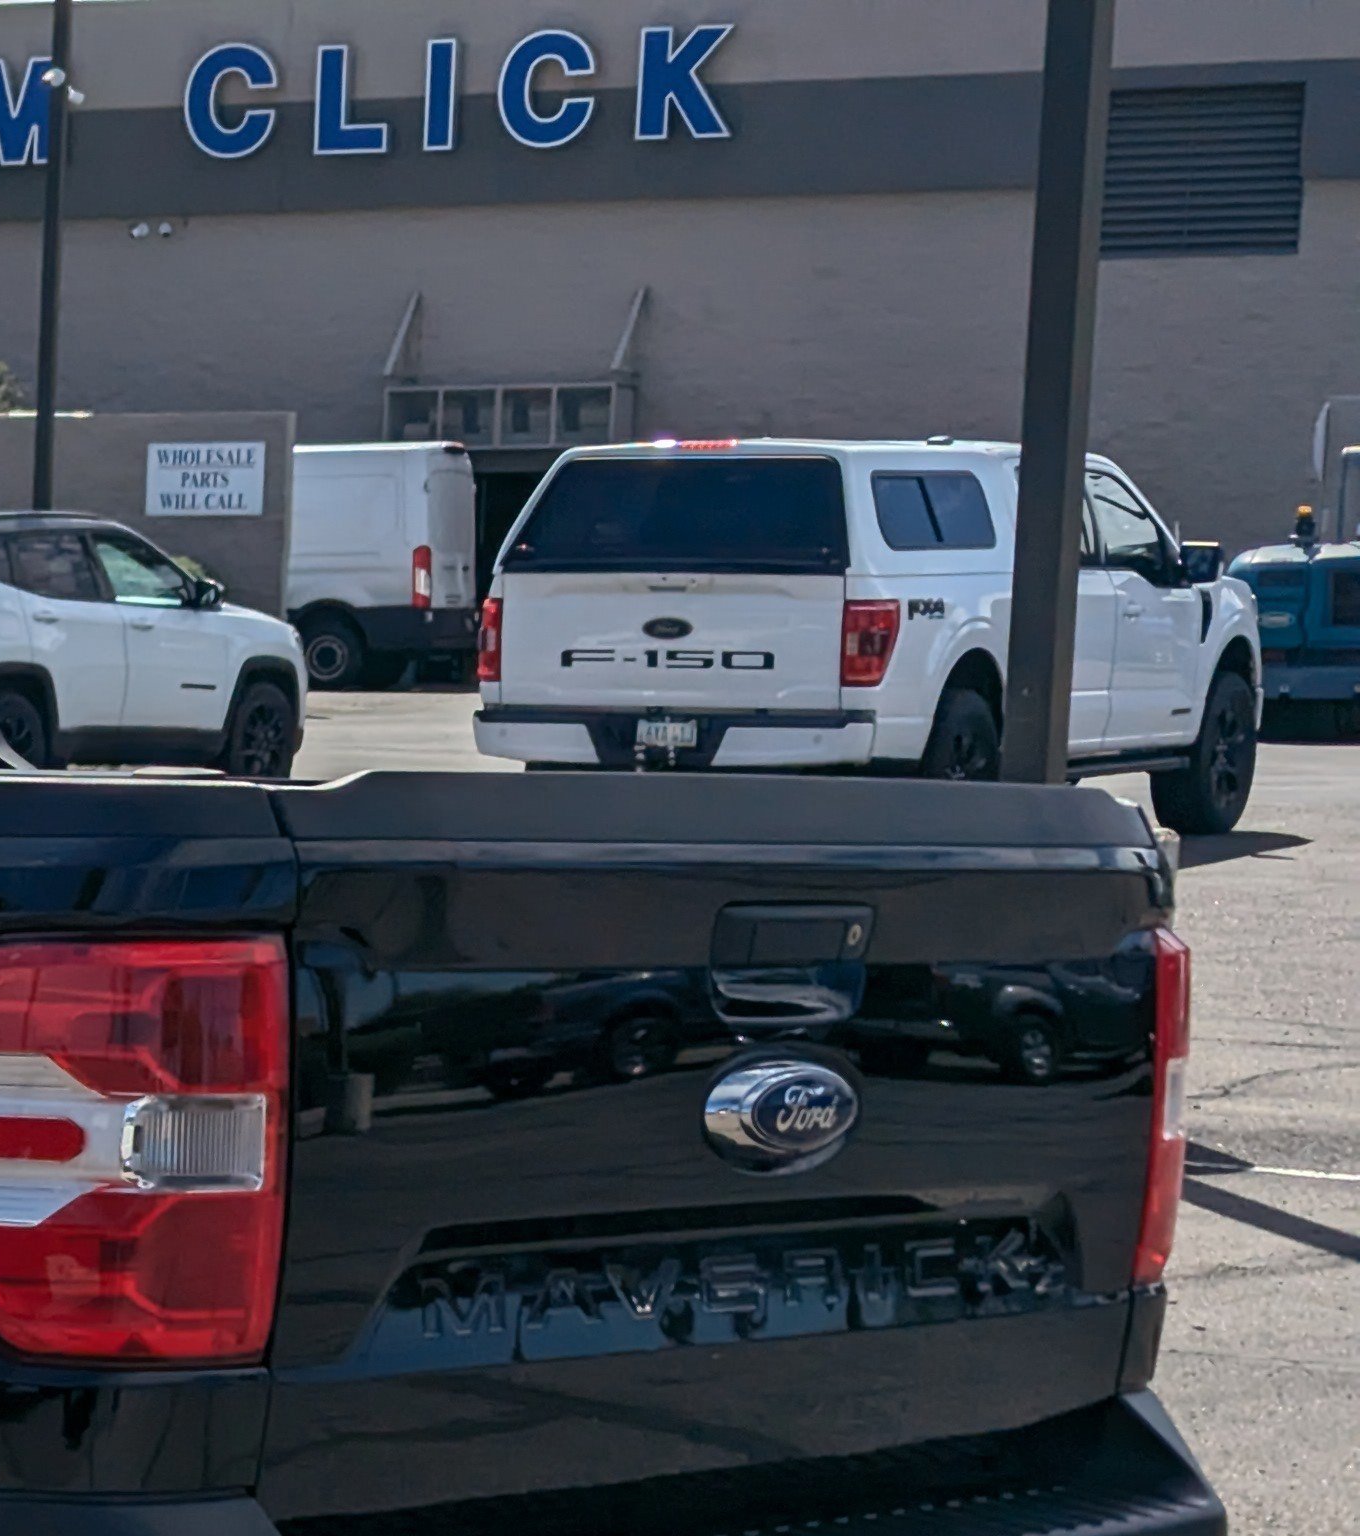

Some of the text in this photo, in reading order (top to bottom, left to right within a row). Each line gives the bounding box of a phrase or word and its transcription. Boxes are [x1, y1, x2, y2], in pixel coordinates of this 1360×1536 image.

[183, 23, 735, 159] CLICK
[157, 448, 256, 467] WHOLESALE
[181, 471, 230, 488] PARTS
[160, 493, 248, 510] WILL CALL
[561, 649, 775, 670] F-150
[775, 1084, 843, 1135] Ford
[420, 1226, 1066, 1340] MAVERICK
